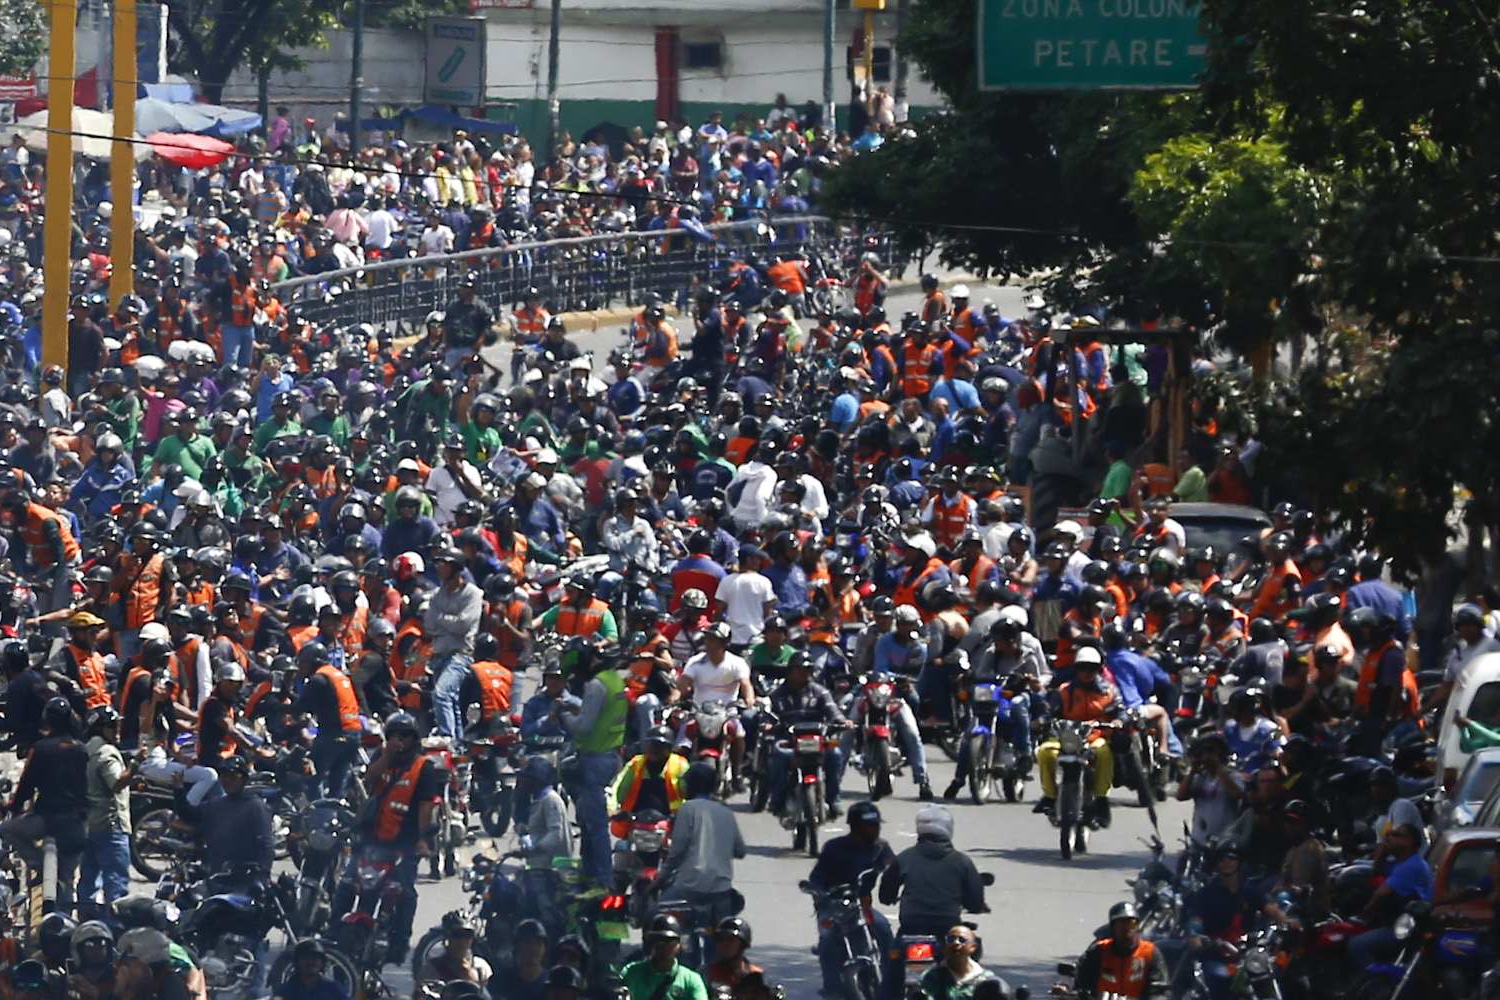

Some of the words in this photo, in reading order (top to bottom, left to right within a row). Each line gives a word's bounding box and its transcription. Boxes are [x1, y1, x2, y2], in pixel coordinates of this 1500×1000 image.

[1001, 0, 1084, 17] ZONA
[1100, 0, 1200, 18] COLON
[1034, 39, 1173, 67] PETARE
